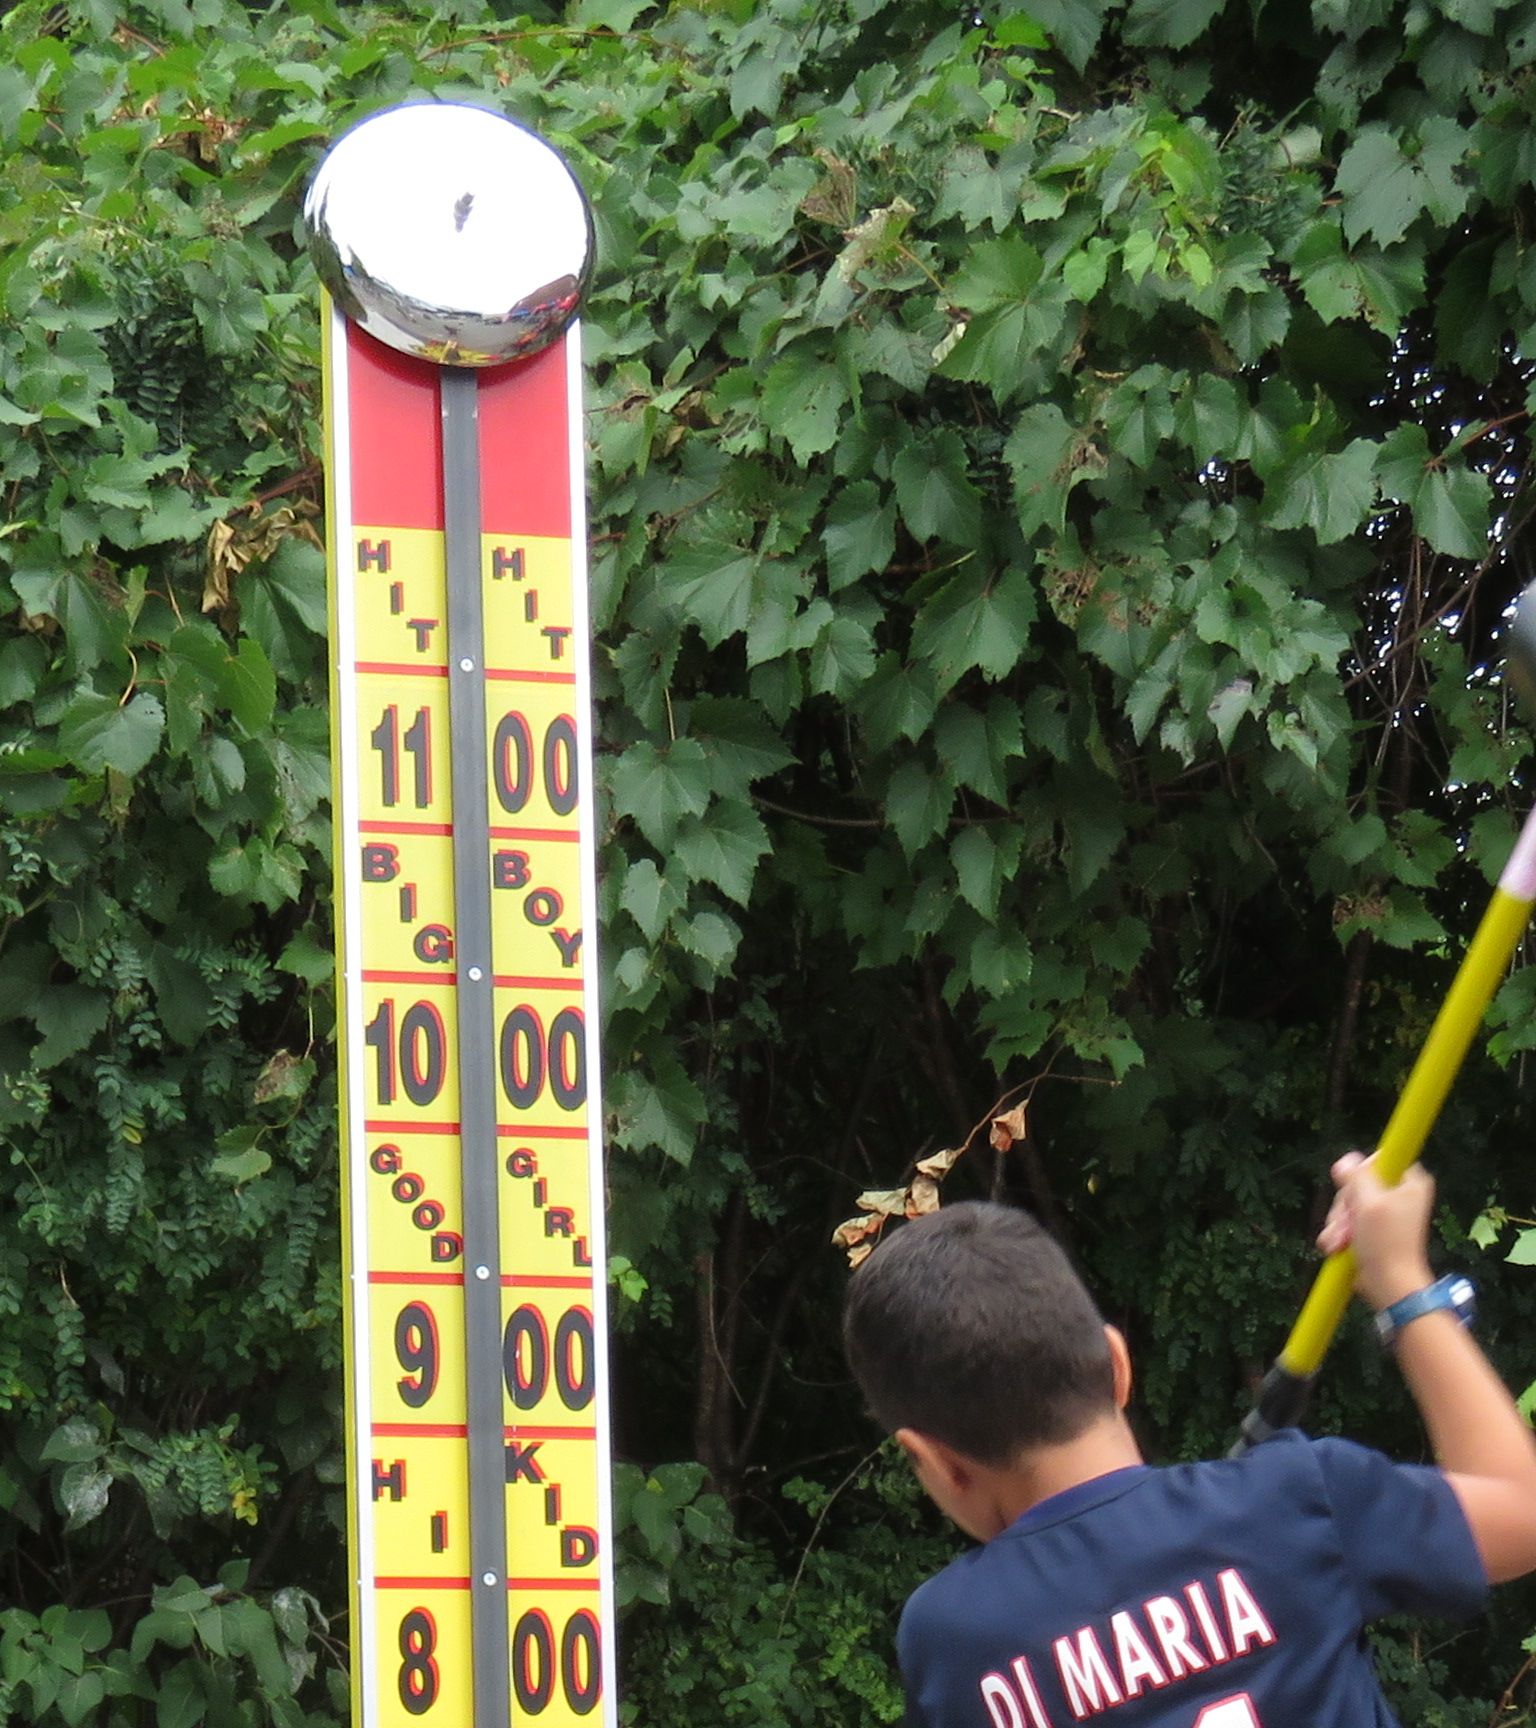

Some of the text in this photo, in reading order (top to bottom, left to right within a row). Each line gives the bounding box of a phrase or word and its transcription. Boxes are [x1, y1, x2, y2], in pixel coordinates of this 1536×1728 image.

[358, 538, 572, 660] HIT HIT
[371, 704, 578, 817] 11 00
[361, 842, 583, 968] BIG BOY
[365, 998, 587, 1111] 10 00
[370, 1143, 592, 1268] GOOD GIRL
[395, 1300, 595, 1411] 9 00
[372, 1441, 599, 1568] HI KID
[398, 1606, 602, 1716] 8 00
[1052, 1568, 1277, 1721] MARIA
